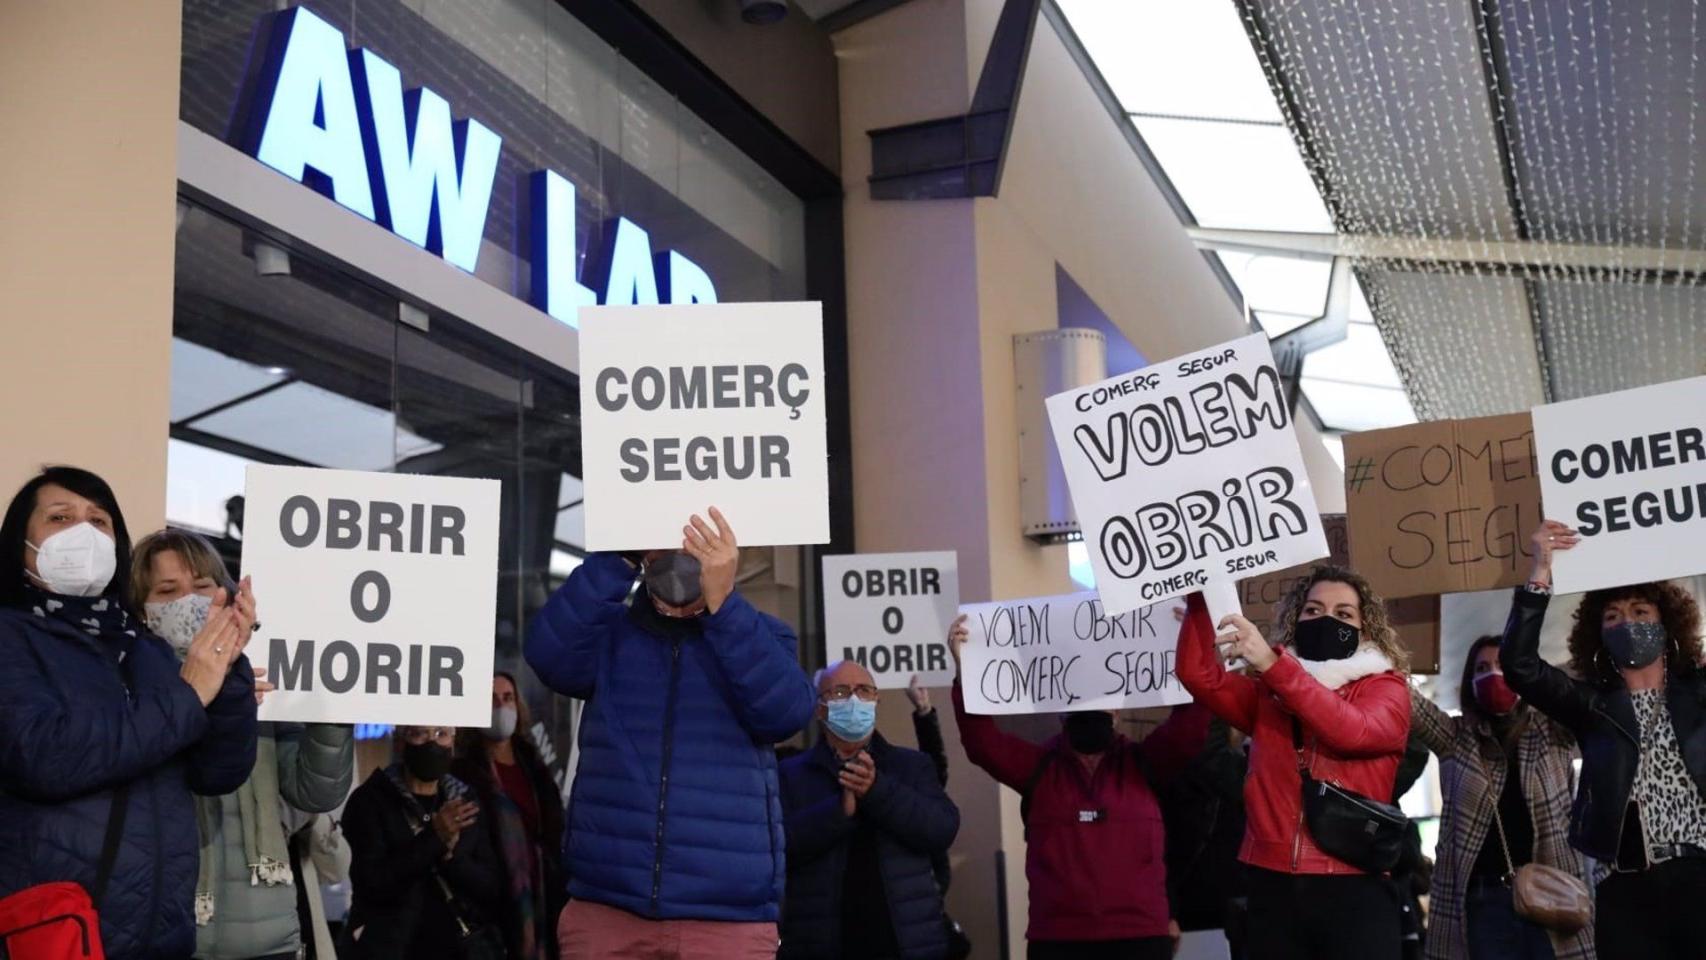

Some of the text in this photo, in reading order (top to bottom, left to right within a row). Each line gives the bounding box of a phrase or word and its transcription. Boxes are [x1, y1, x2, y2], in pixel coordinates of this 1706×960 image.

[256, 5, 502, 273] AW
[595, 363, 810, 420] COMERÇ
[1075, 349, 1238, 412] COMERÇ SEGUR
[1074, 365, 1287, 481] VOLEM
[619, 435, 792, 483] SEGUR
[279, 495, 466, 556] OBRIR
[350, 570, 391, 623] O
[842, 568, 941, 598] OBRIR
[1141, 550, 1279, 600] COMERÇ SEGUR
[882, 606, 904, 634] O
[980, 600, 1157, 648] VOLEM OBRIR
[267, 638, 464, 697] MORIR
[843, 643, 947, 673] MORIR
[980, 650, 1181, 705] COMERÇ SEGUR
